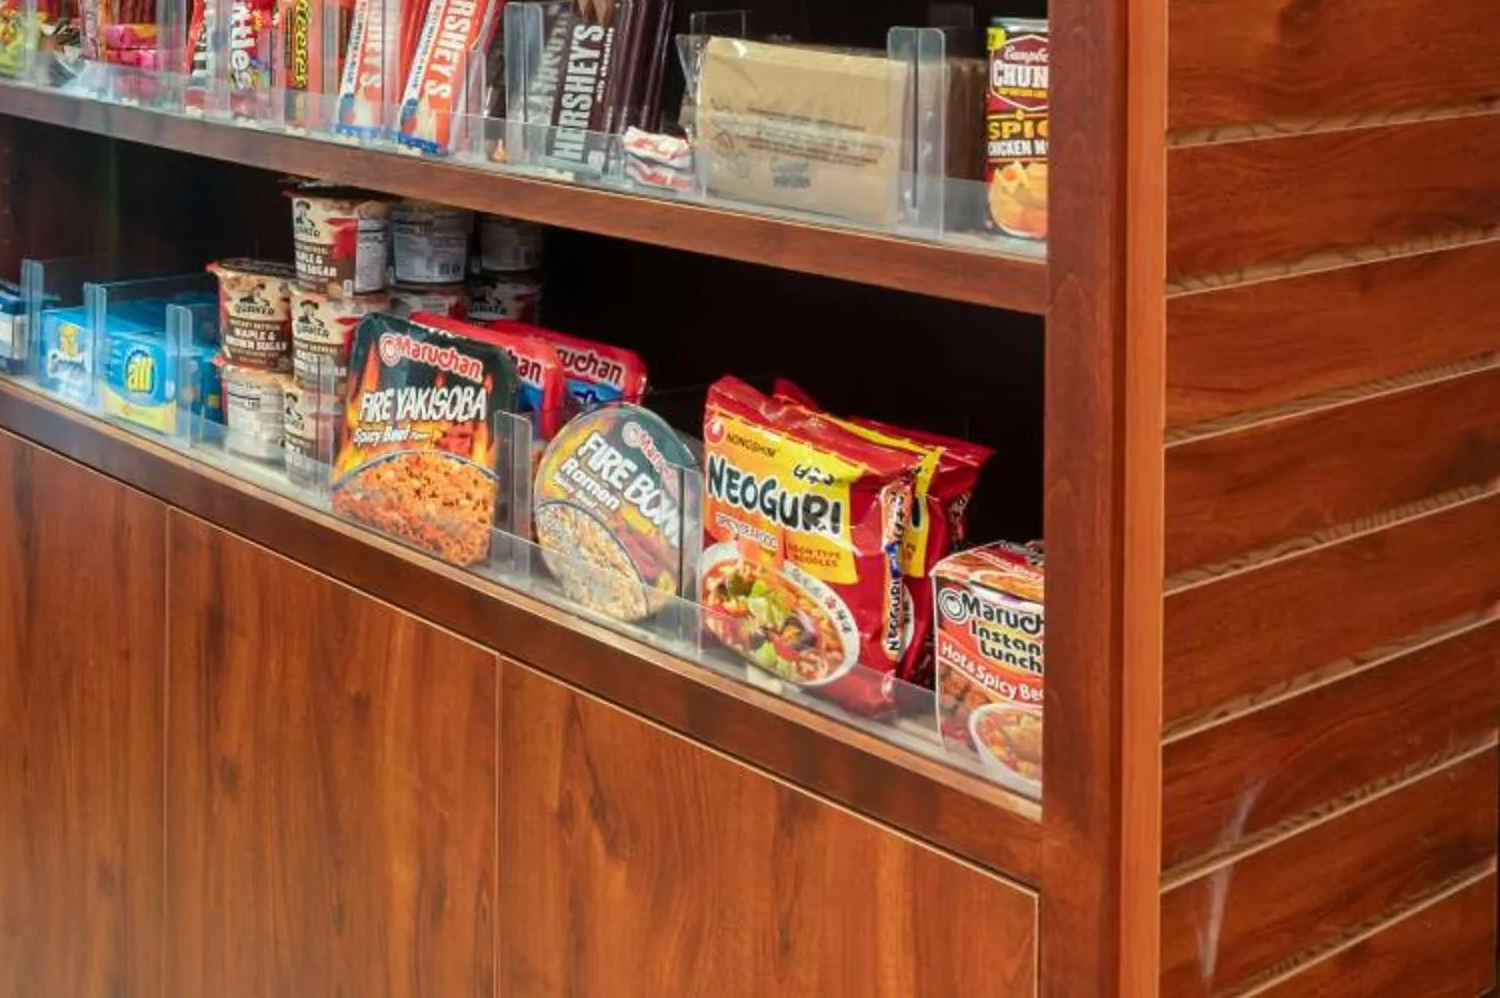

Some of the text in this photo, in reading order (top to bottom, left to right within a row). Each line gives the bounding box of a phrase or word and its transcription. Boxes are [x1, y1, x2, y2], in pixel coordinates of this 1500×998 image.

[550, 24, 605, 164] HERSHEY'S
[993, 58, 1048, 88] CHUN
[127, 357, 154, 393] all
[394, 333, 484, 384] Maruchan
[360, 385, 487, 423] FIRE YAKISOBA
[577, 431, 639, 491] FIRE
[707, 455, 842, 535] NEOGURI
[971, 620, 1042, 658] Instan
[980, 640, 1043, 674] Lunch
[941, 641, 963, 671] Hot
[976, 663, 1018, 700] Spicy
